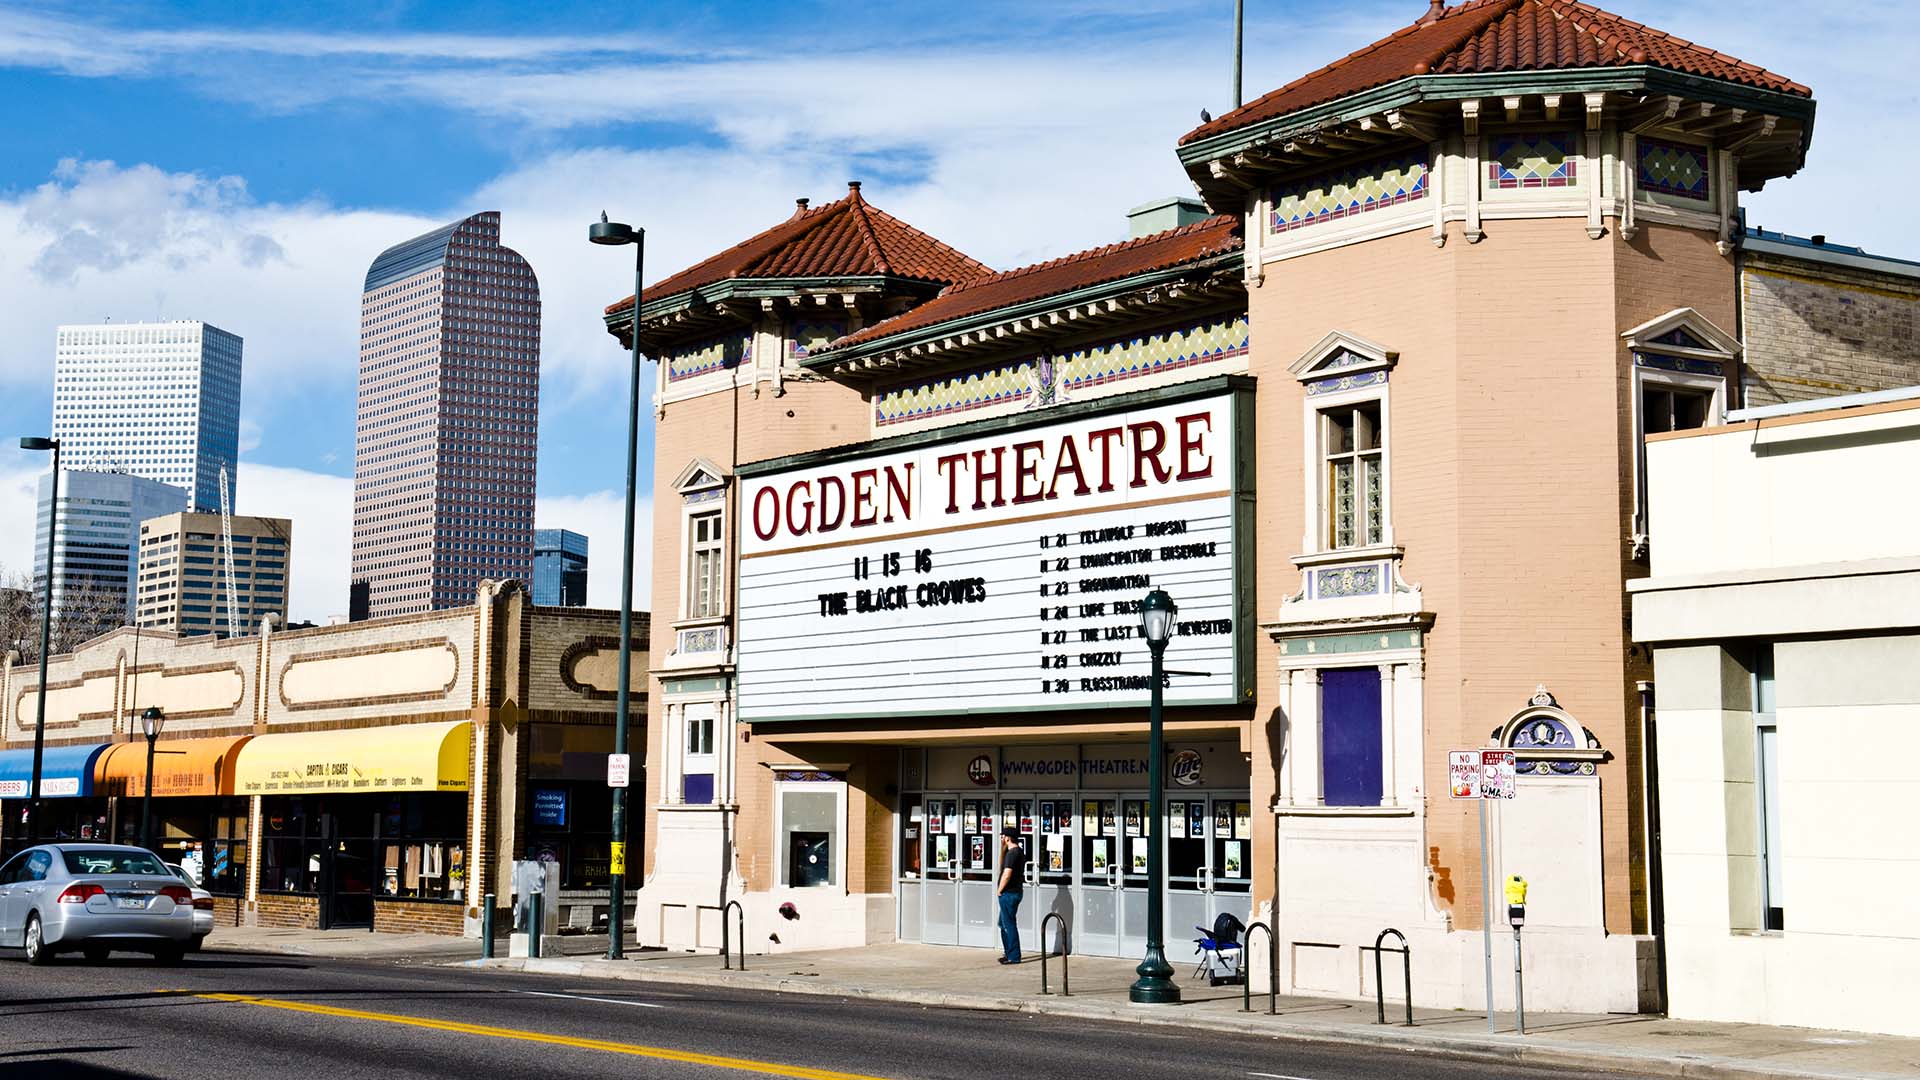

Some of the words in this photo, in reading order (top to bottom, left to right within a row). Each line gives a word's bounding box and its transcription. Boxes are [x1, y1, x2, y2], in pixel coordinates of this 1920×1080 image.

[753, 462, 914, 541] OGDEN
[937, 411, 1213, 514] THEATRE
[1056, 533, 1067, 547] 21
[1080, 525, 1135, 544] YELAWOLF
[854, 556, 868, 580] 11
[882, 552, 900, 577] 15
[915, 548, 932, 573] 16
[1056, 557, 1069, 571] 22
[1080, 549, 1152, 569] EMANCIPATOR
[1160, 542, 1216, 561] ENSEMBLE
[818, 592, 848, 617] THE
[855, 585, 908, 613] BLACK
[917, 577, 986, 608] CROWES
[1055, 581, 1069, 596] 23
[1080, 600, 1105, 617] LUPE
[1113, 599, 1145, 614] FIASC
[1054, 630, 1067, 644] 27
[1079, 628, 1099, 642] THE
[1105, 626, 1132, 641] LAST
[1177, 618, 1233, 636] REVISITED
[1054, 654, 1068, 669] 29
[1080, 674, 1171, 692] FLOSSTRADAMS
[1002, 759, 1150, 775] WWW.OGDENTHEATRE.N
[1460, 754, 1469, 763] NO
[306, 764, 324, 777] CAPITOL
[331, 762, 349, 776] CIGARS
[1451, 764, 1480, 774] PARKING
[536, 794, 562, 802] Smoking
